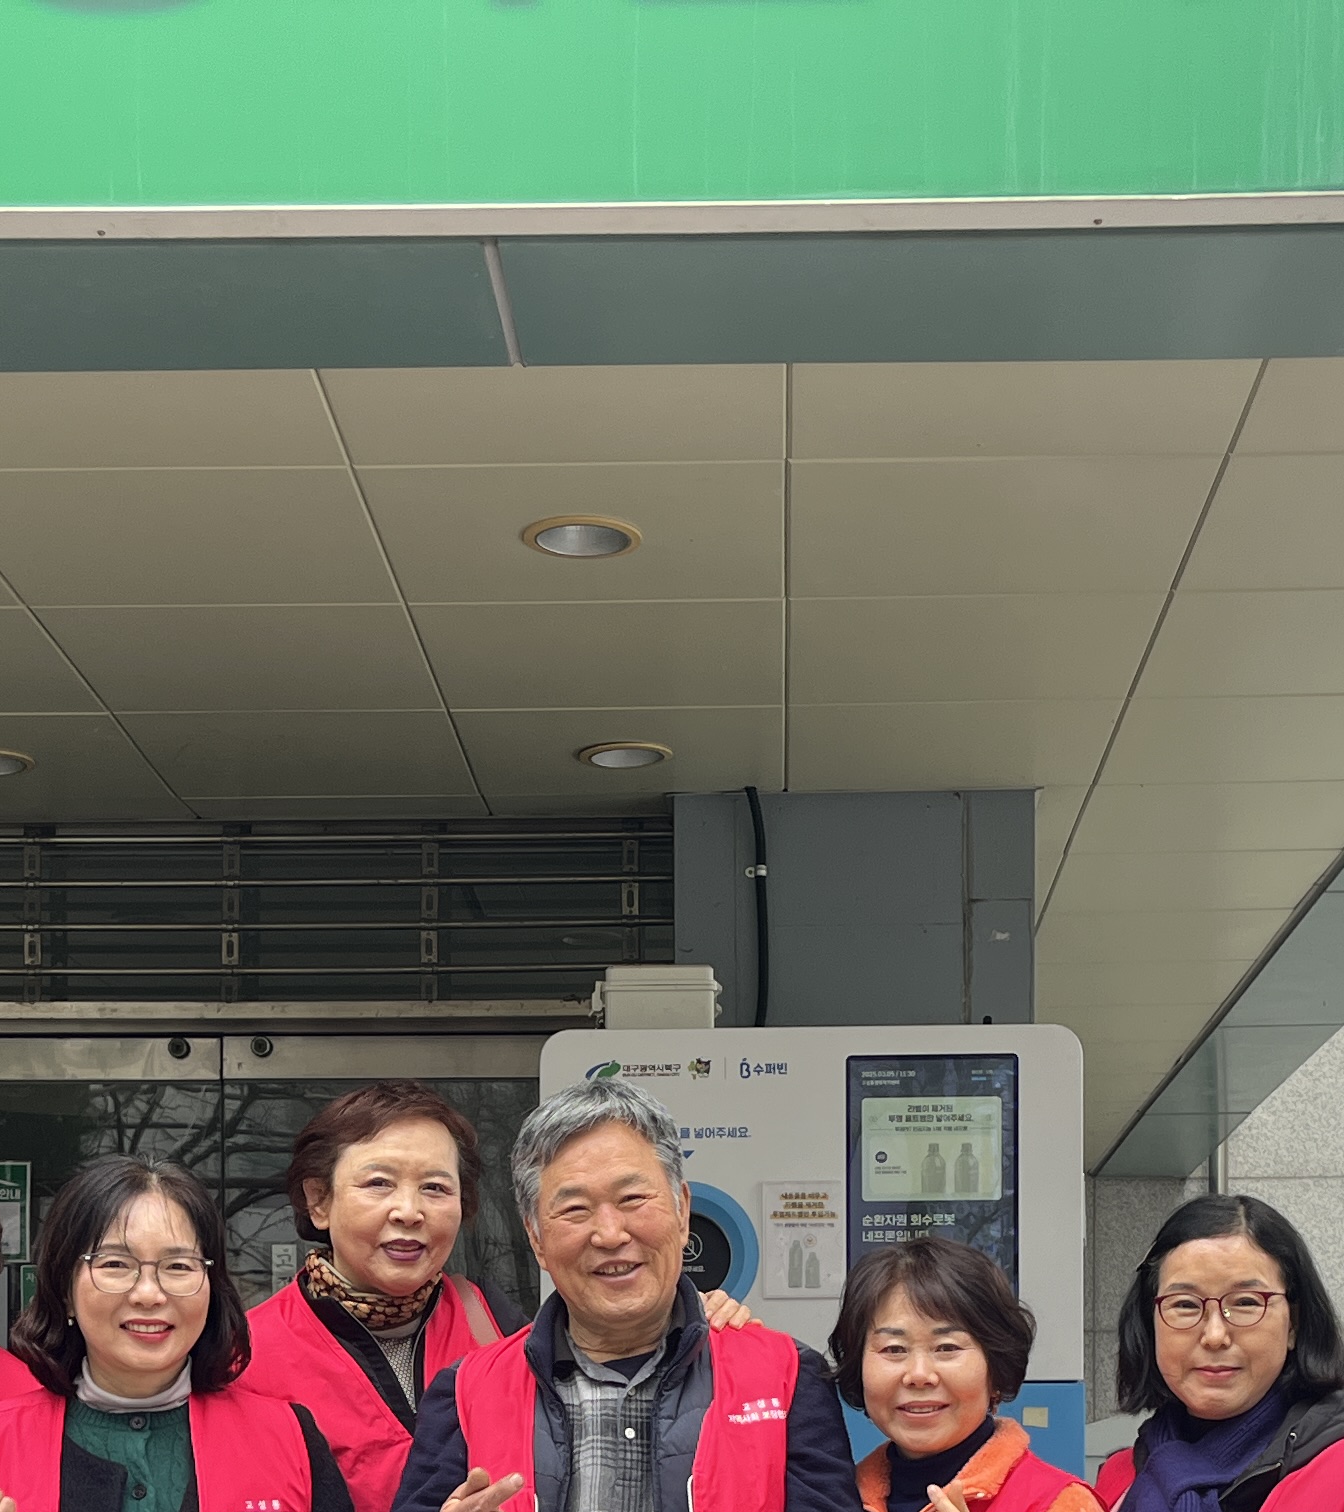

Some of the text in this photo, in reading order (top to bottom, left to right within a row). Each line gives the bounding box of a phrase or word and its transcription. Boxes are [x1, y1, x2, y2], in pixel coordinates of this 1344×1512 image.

[752, 1061, 788, 1075] 수퍼빈
[693, 1126, 752, 1139] 넣어주세요.
[862, 1213, 956, 1227] 순환자원 회수로봇
